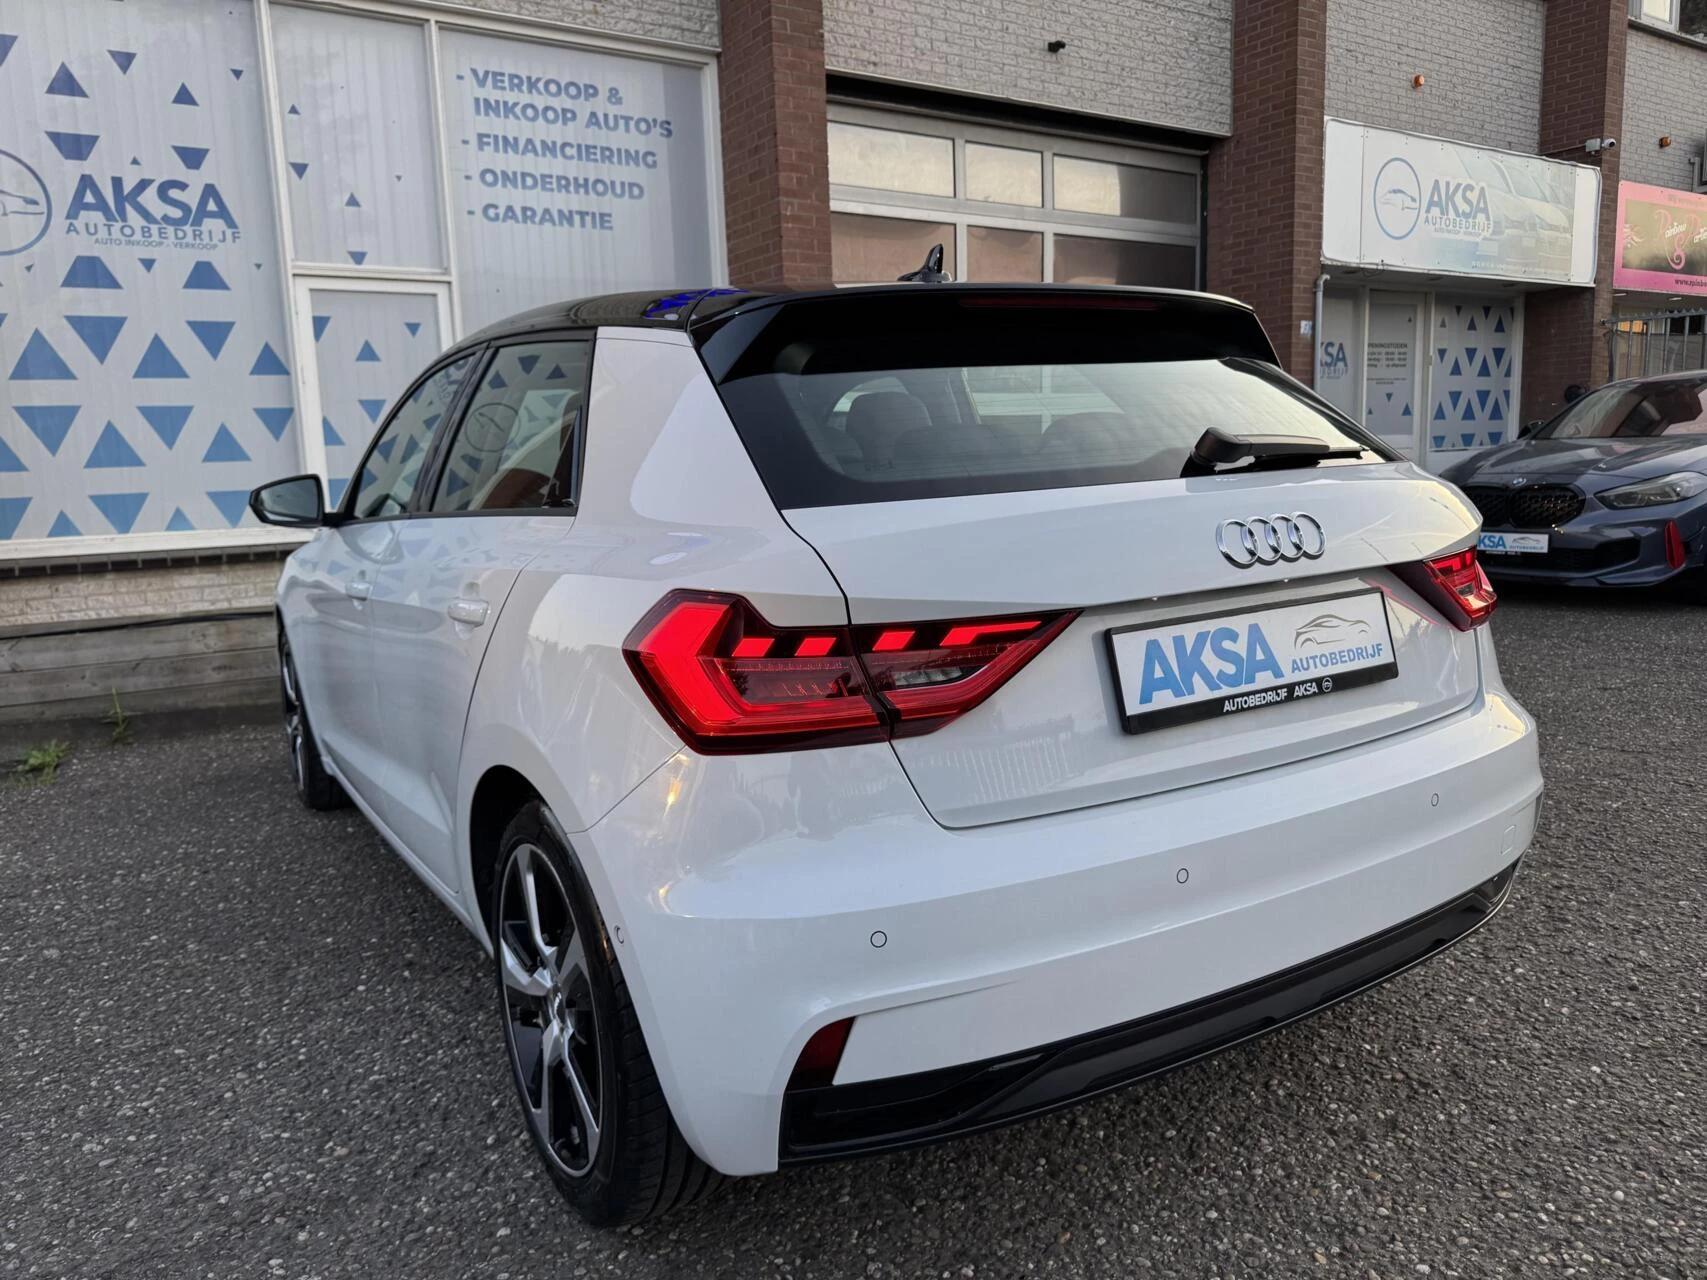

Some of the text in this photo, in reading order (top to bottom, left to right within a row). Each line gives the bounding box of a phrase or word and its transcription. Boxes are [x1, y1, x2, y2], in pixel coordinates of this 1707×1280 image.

[470, 68, 599, 101] VERKOOP
[607, 87, 623, 105] &
[473, 97, 673, 138] INKOOP AUTO'S
[476, 132, 658, 169] FINANCIERING
[479, 168, 644, 200] ONDERHOUD
[65, 174, 239, 229] AKSA
[1425, 179, 1490, 221] AKSA
[482, 203, 613, 231] GARANTIE
[1424, 216, 1492, 233] AUTOBEDRIJF
[65, 222, 242, 244] AUTOBEDRIJF
[94, 237, 122, 247] AUTO
[124, 238, 164, 248] INKOOP
[172, 241, 219, 251] VERKOOP
[1320, 341, 1348, 369] SA
[1479, 534, 1506, 549] KSA
[1139, 622, 1285, 705] AKSA
[1290, 643, 1383, 673] AUTOBEDRIJF
[1223, 681, 1318, 712] AUTOBEDRIJF AKSA
